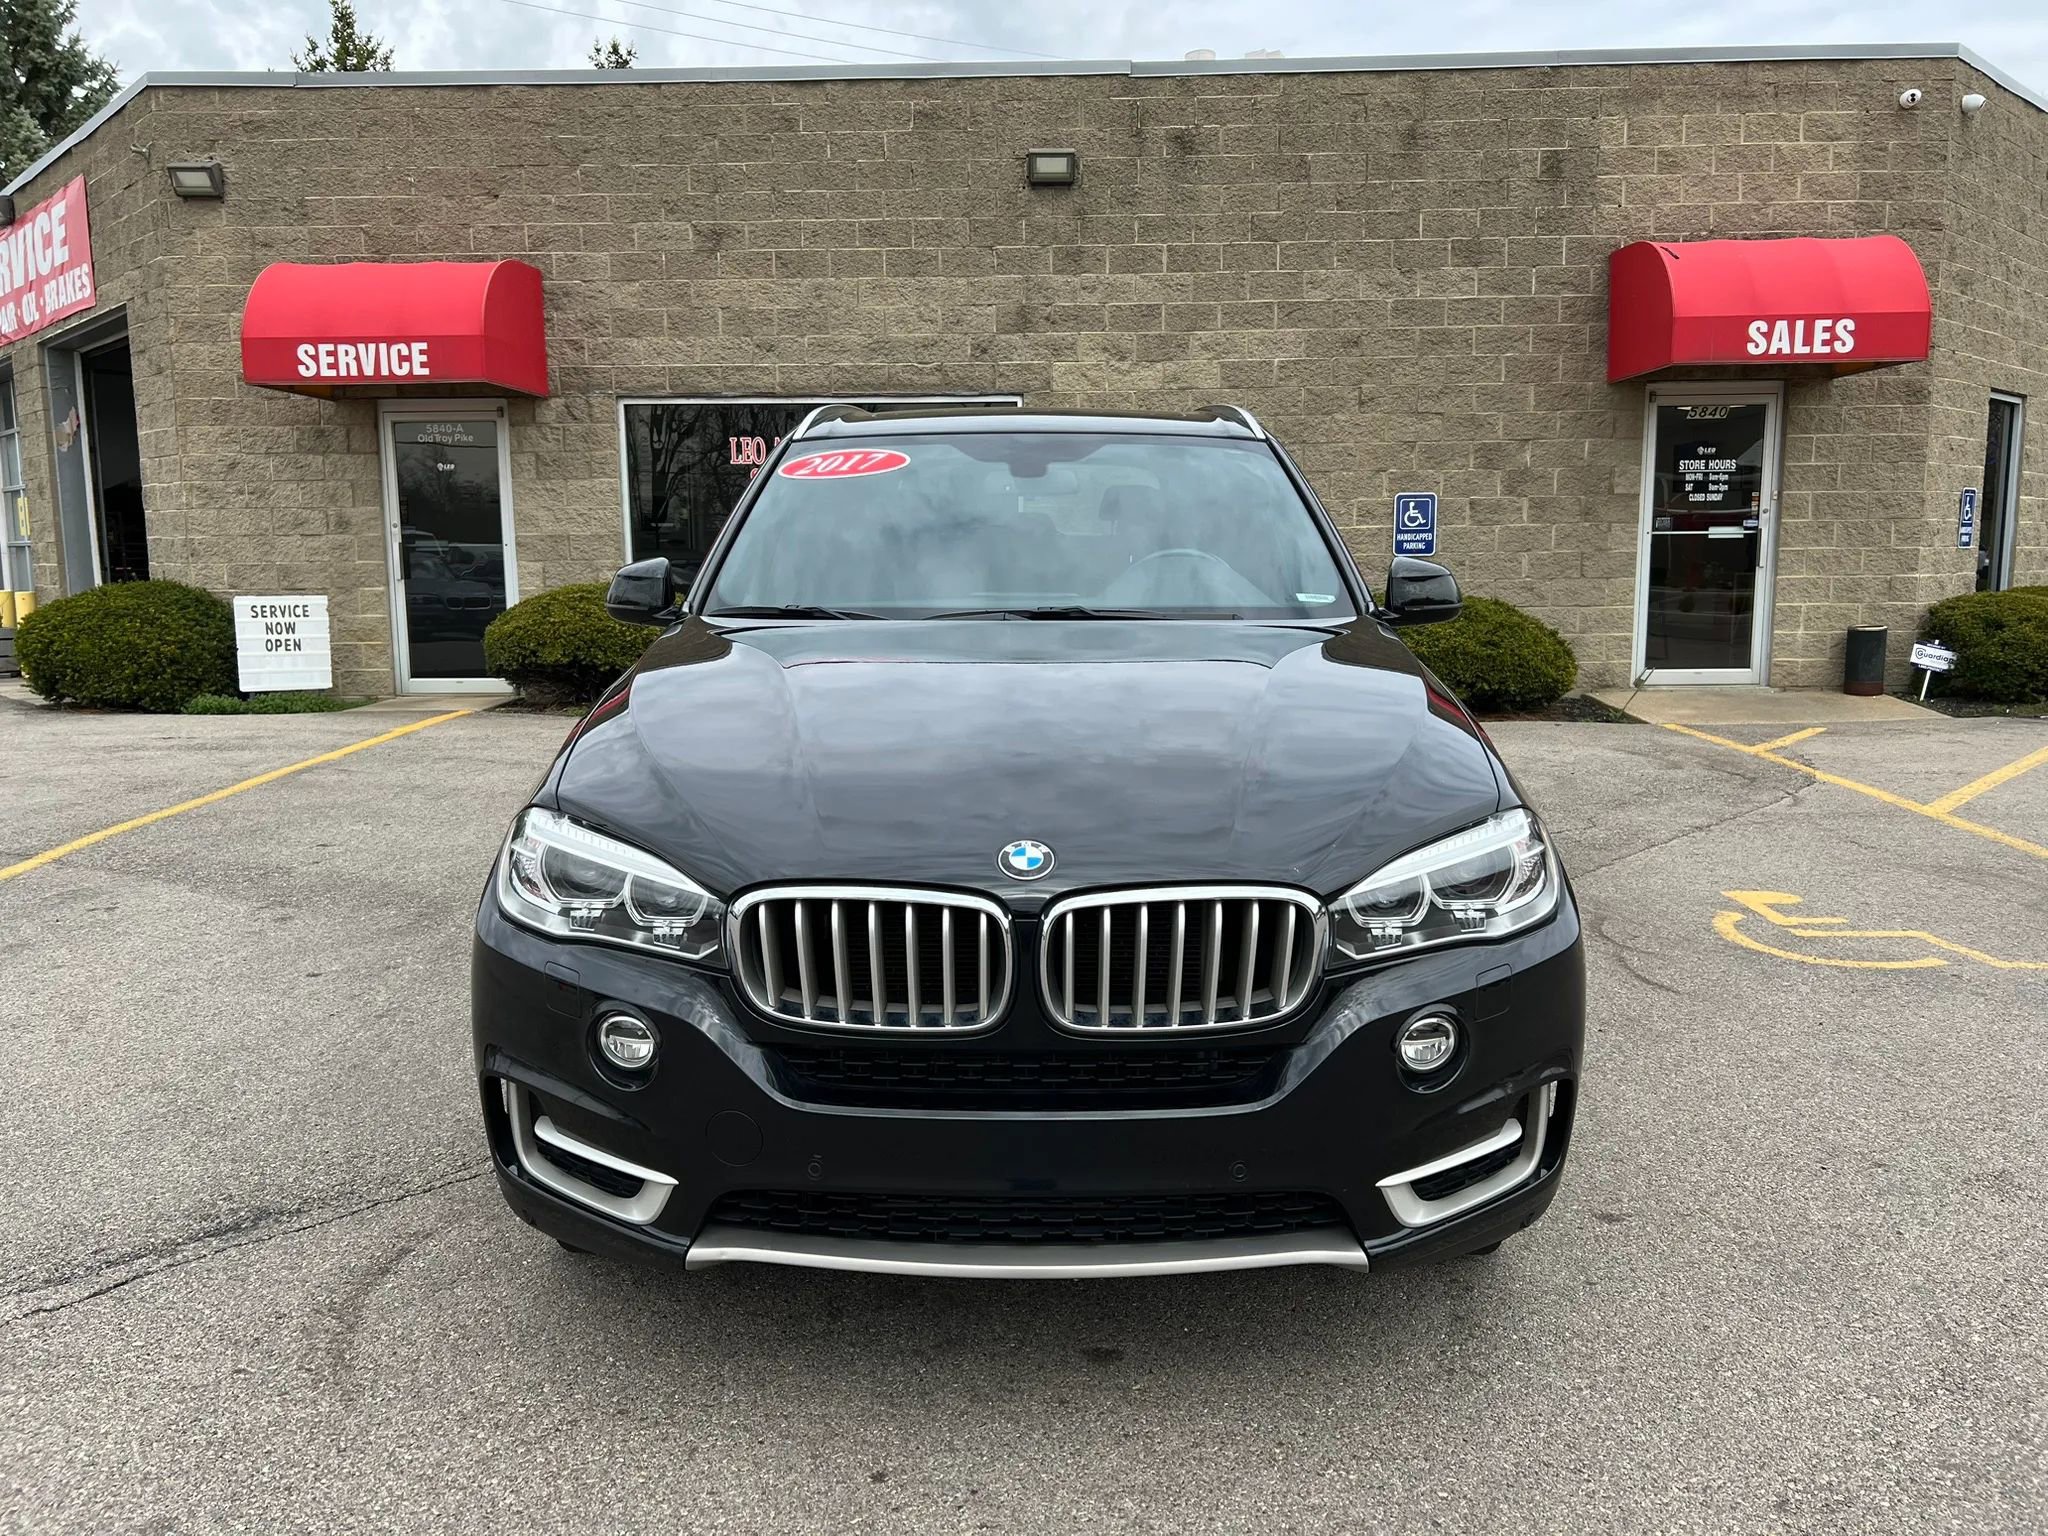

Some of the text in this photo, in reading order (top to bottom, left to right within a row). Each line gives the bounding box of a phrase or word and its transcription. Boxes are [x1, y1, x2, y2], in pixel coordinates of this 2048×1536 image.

[44, 263, 91, 315] BRAKES
[1746, 318, 1856, 355] SALES
[297, 342, 430, 377] SERVICE
[1689, 406, 1728, 418] 5840
[426, 424, 464, 433] 5840-A
[417, 433, 474, 444] Old Troy Pike
[729, 436, 766, 464] LEO
[795, 453, 888, 475] 2017
[1679, 459, 1737, 470] STORE HOURS
[1685, 483, 1694, 491] SAT
[1688, 493, 1723, 501] CLOSED SUNDAY
[1396, 532, 1432, 541] HANDICAPPED
[1403, 541, 1425, 550] PARKING
[250, 604, 310, 618] SERVICE
[265, 621, 296, 635] NOW
[265, 638, 302, 652] OPEN
